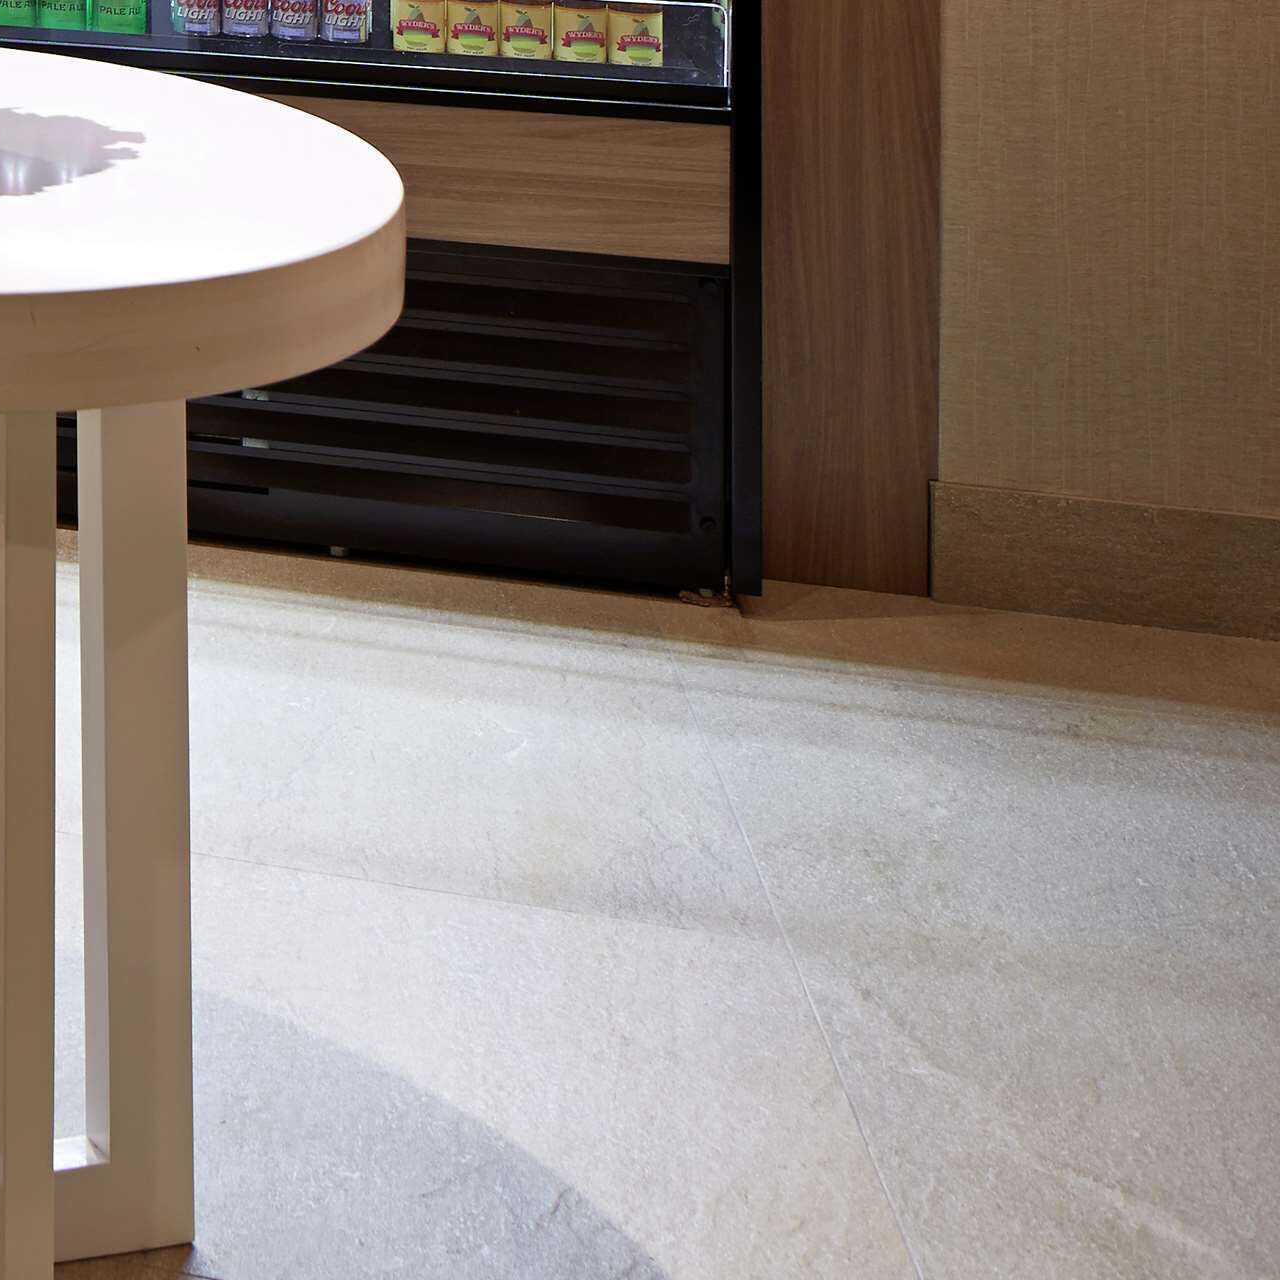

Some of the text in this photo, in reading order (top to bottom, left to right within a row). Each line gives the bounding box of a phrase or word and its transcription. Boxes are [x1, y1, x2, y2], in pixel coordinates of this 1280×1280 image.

[42, 0, 66, 11] PALE
[100, 7, 125, 16] PALE
[177, 7, 219, 20] LIGHT
[225, 7, 267, 23] LIGHT
[272, 10, 314, 25] LIGHT
[325, 12, 367, 27] LIGHT
